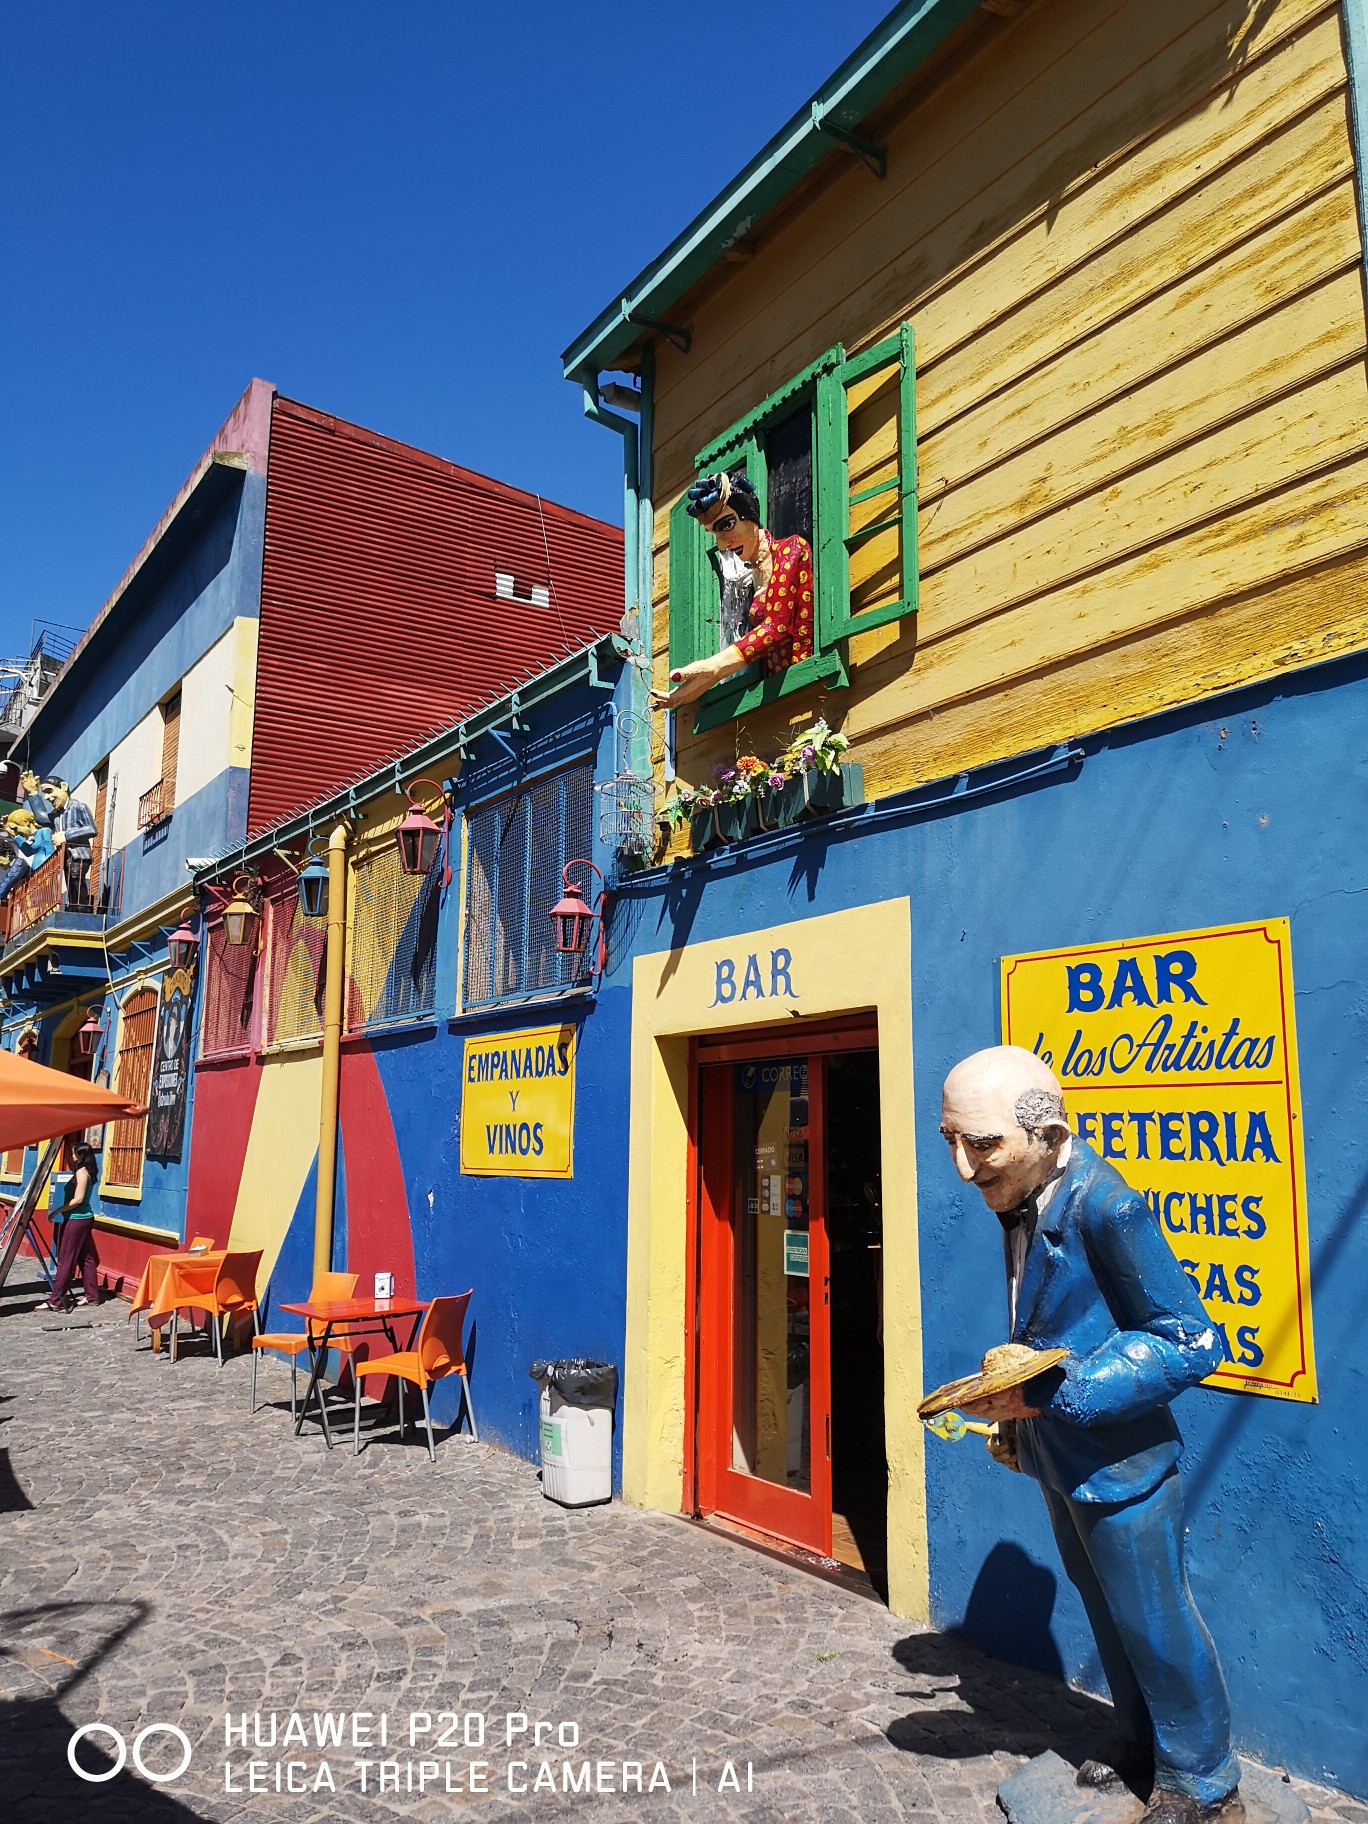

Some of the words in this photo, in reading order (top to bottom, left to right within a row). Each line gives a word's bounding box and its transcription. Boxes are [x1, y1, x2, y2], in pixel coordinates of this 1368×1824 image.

[707, 948, 801, 1008] BAR
[1065, 950, 1208, 1013] BAR
[467, 1042, 569, 1083] EMPANADAS
[1061, 1030, 1107, 1077] los
[1110, 1014, 1275, 1073] Artistas
[508, 1090, 520, 1112] Y
[486, 1122, 544, 1156] VINOS
[787, 1152, 803, 1163] VISA
[1066, 1110, 1282, 1166] FETERIA
[1142, 1187, 1267, 1240] ICHES
[1179, 1259, 1262, 1306] SAS
